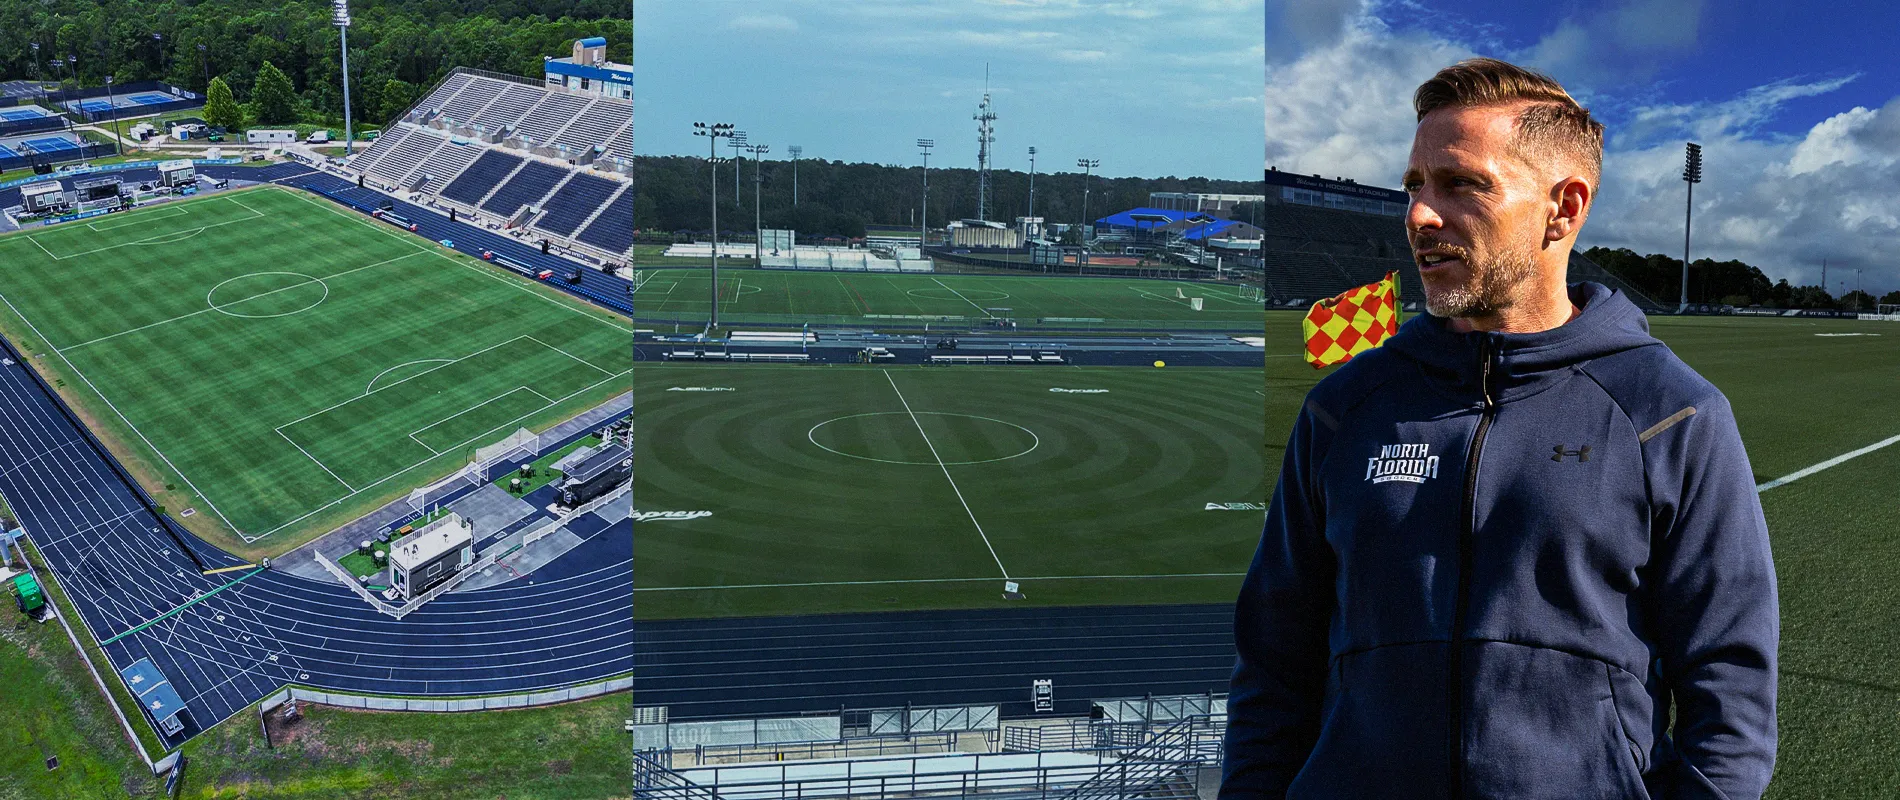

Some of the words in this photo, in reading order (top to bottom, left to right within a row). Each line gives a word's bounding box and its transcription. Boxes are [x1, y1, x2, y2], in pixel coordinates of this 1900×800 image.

[1325, 183, 1357, 193] HODGES
[1358, 188, 1390, 198] STADIUM
[1380, 443, 1430, 459] NORTH
[1364, 455, 1440, 481] FLORIDA
[632, 509, 713, 523] spreys
